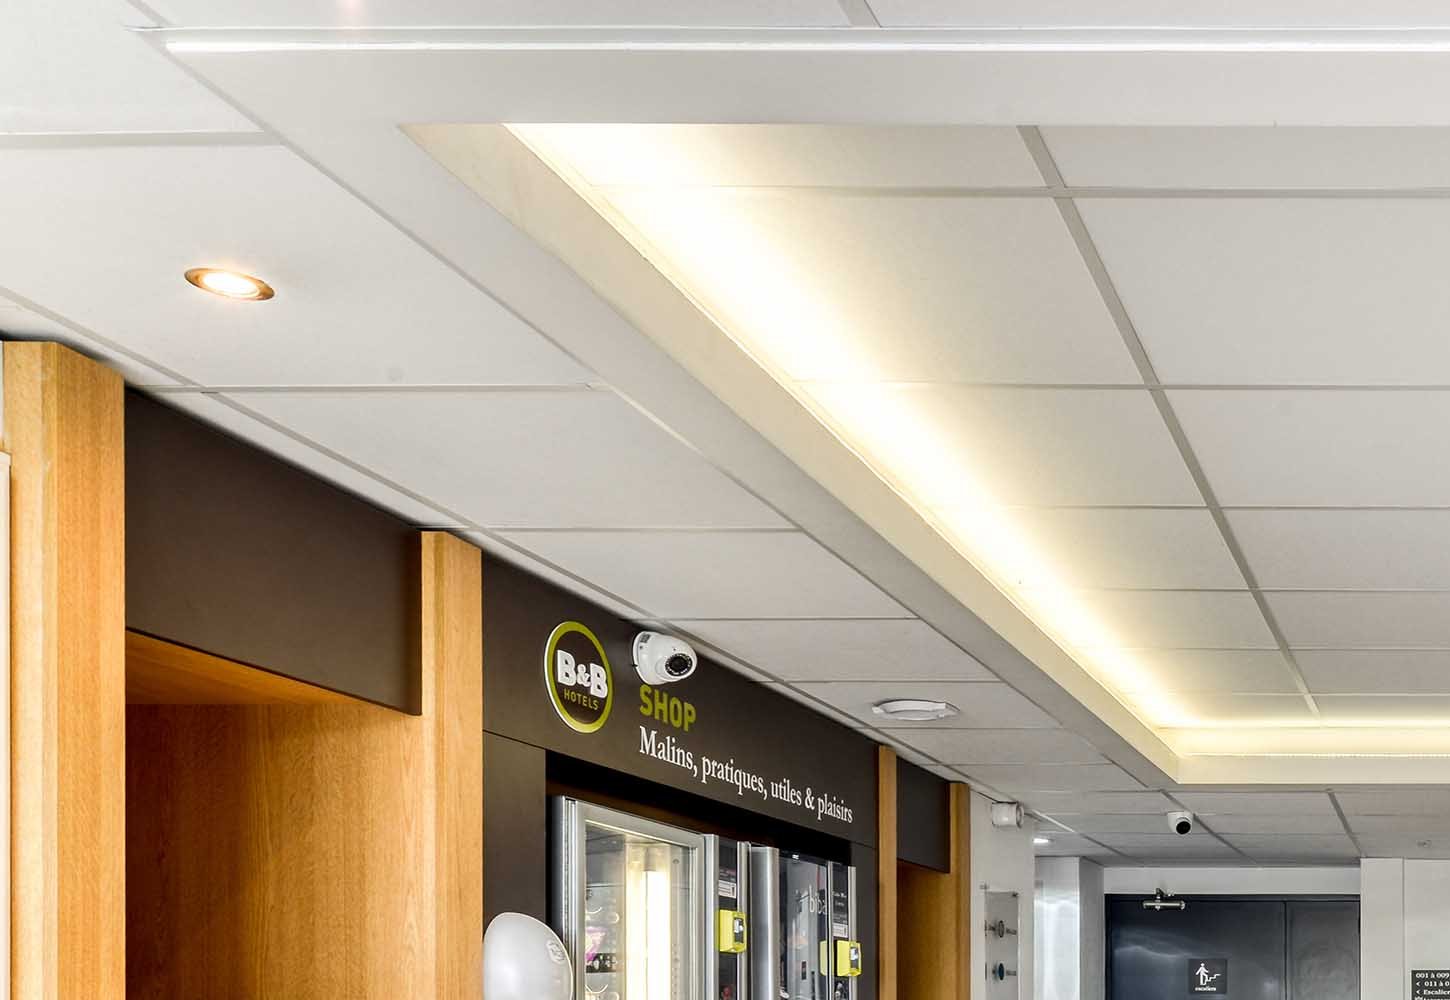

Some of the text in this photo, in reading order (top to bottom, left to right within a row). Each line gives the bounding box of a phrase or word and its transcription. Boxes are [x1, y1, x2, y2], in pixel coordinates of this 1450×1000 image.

[557, 649, 608, 698] B&B
[563, 688, 599, 711] HOTELS
[640, 684, 697, 732] SHOP
[639, 725, 853, 824] Malins, pratiques, utiles & plaisirs
